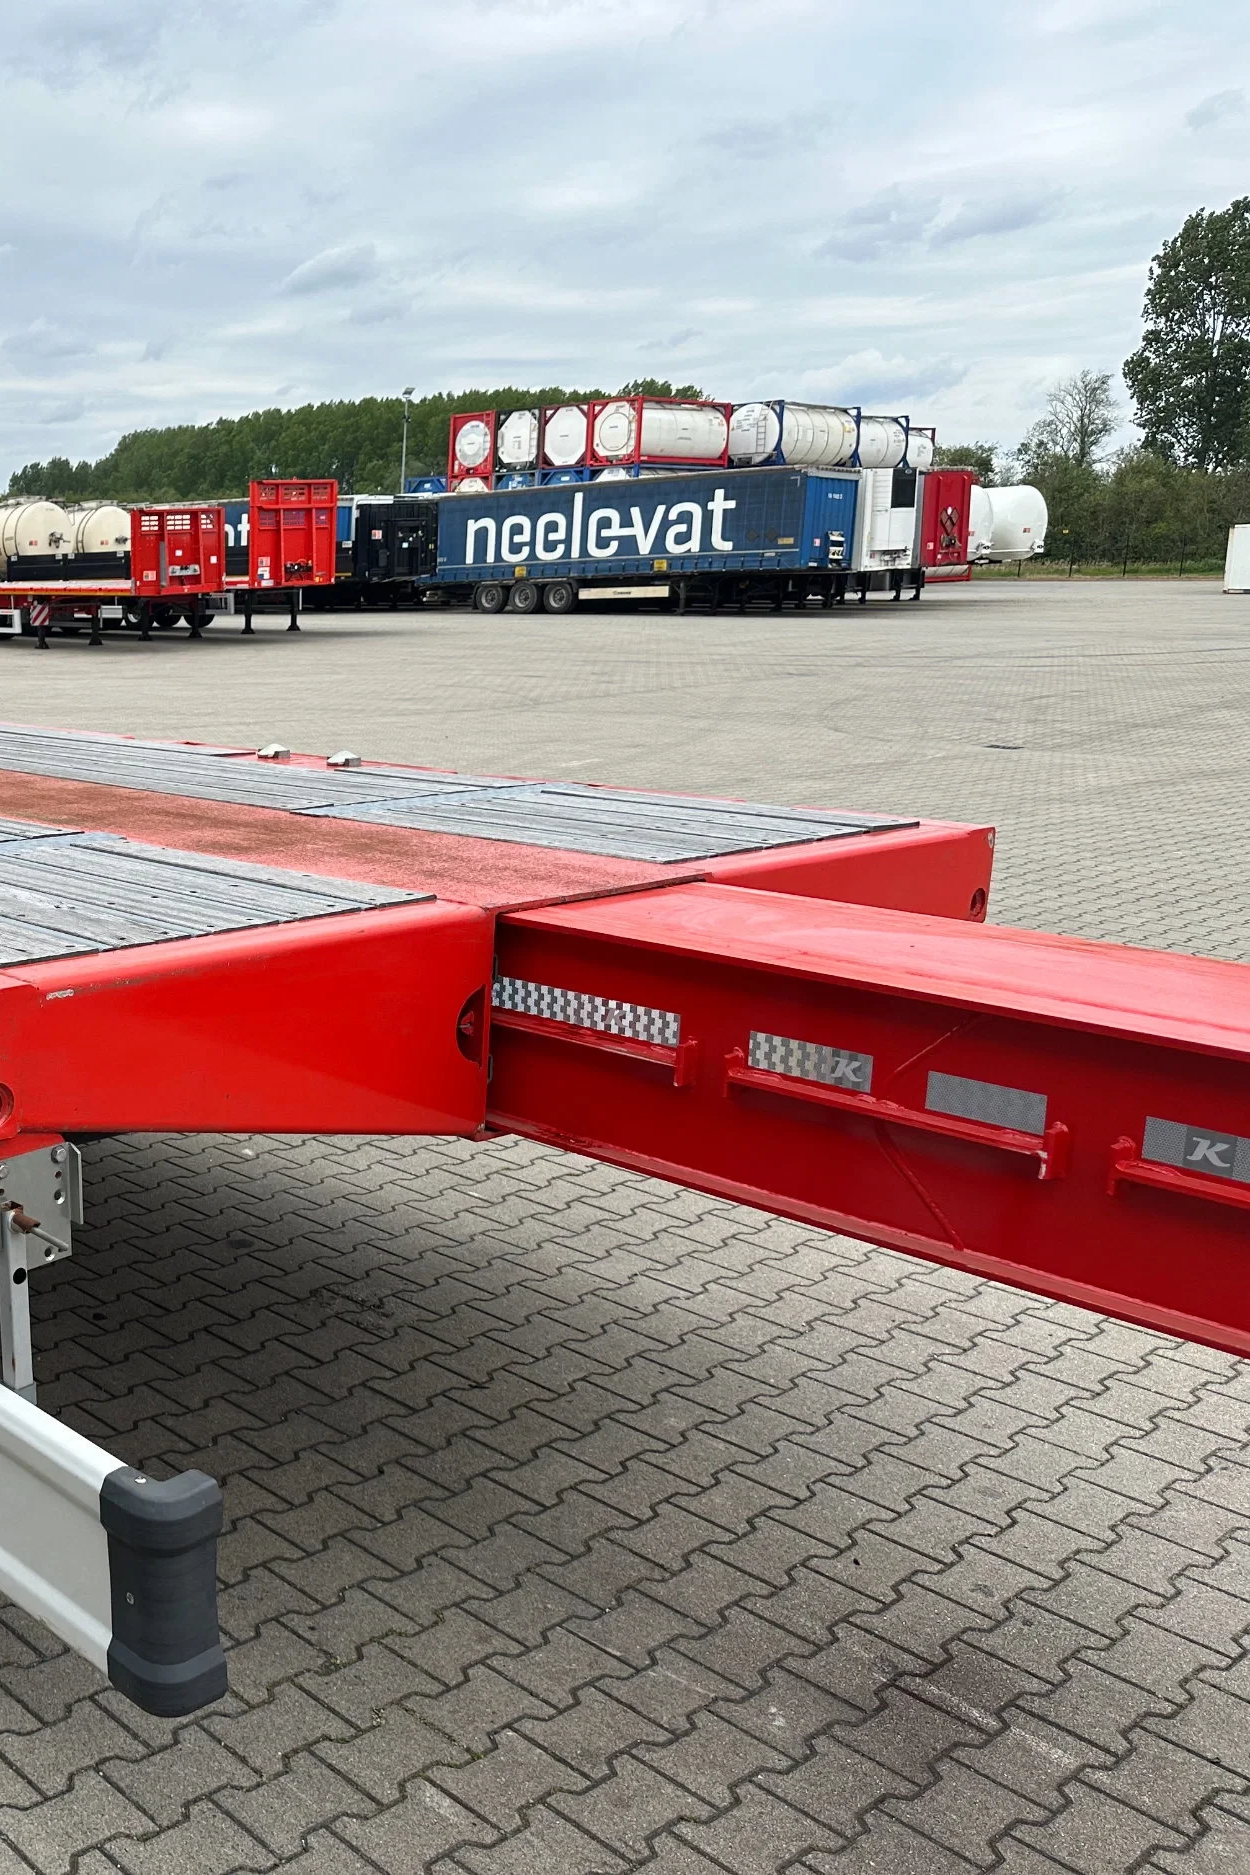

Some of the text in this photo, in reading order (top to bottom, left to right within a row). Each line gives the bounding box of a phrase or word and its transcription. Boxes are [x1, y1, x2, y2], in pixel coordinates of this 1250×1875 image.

[465, 488, 737, 565] neelevat
[830, 1056, 863, 1082] K
[1186, 1136, 1231, 1168] K
